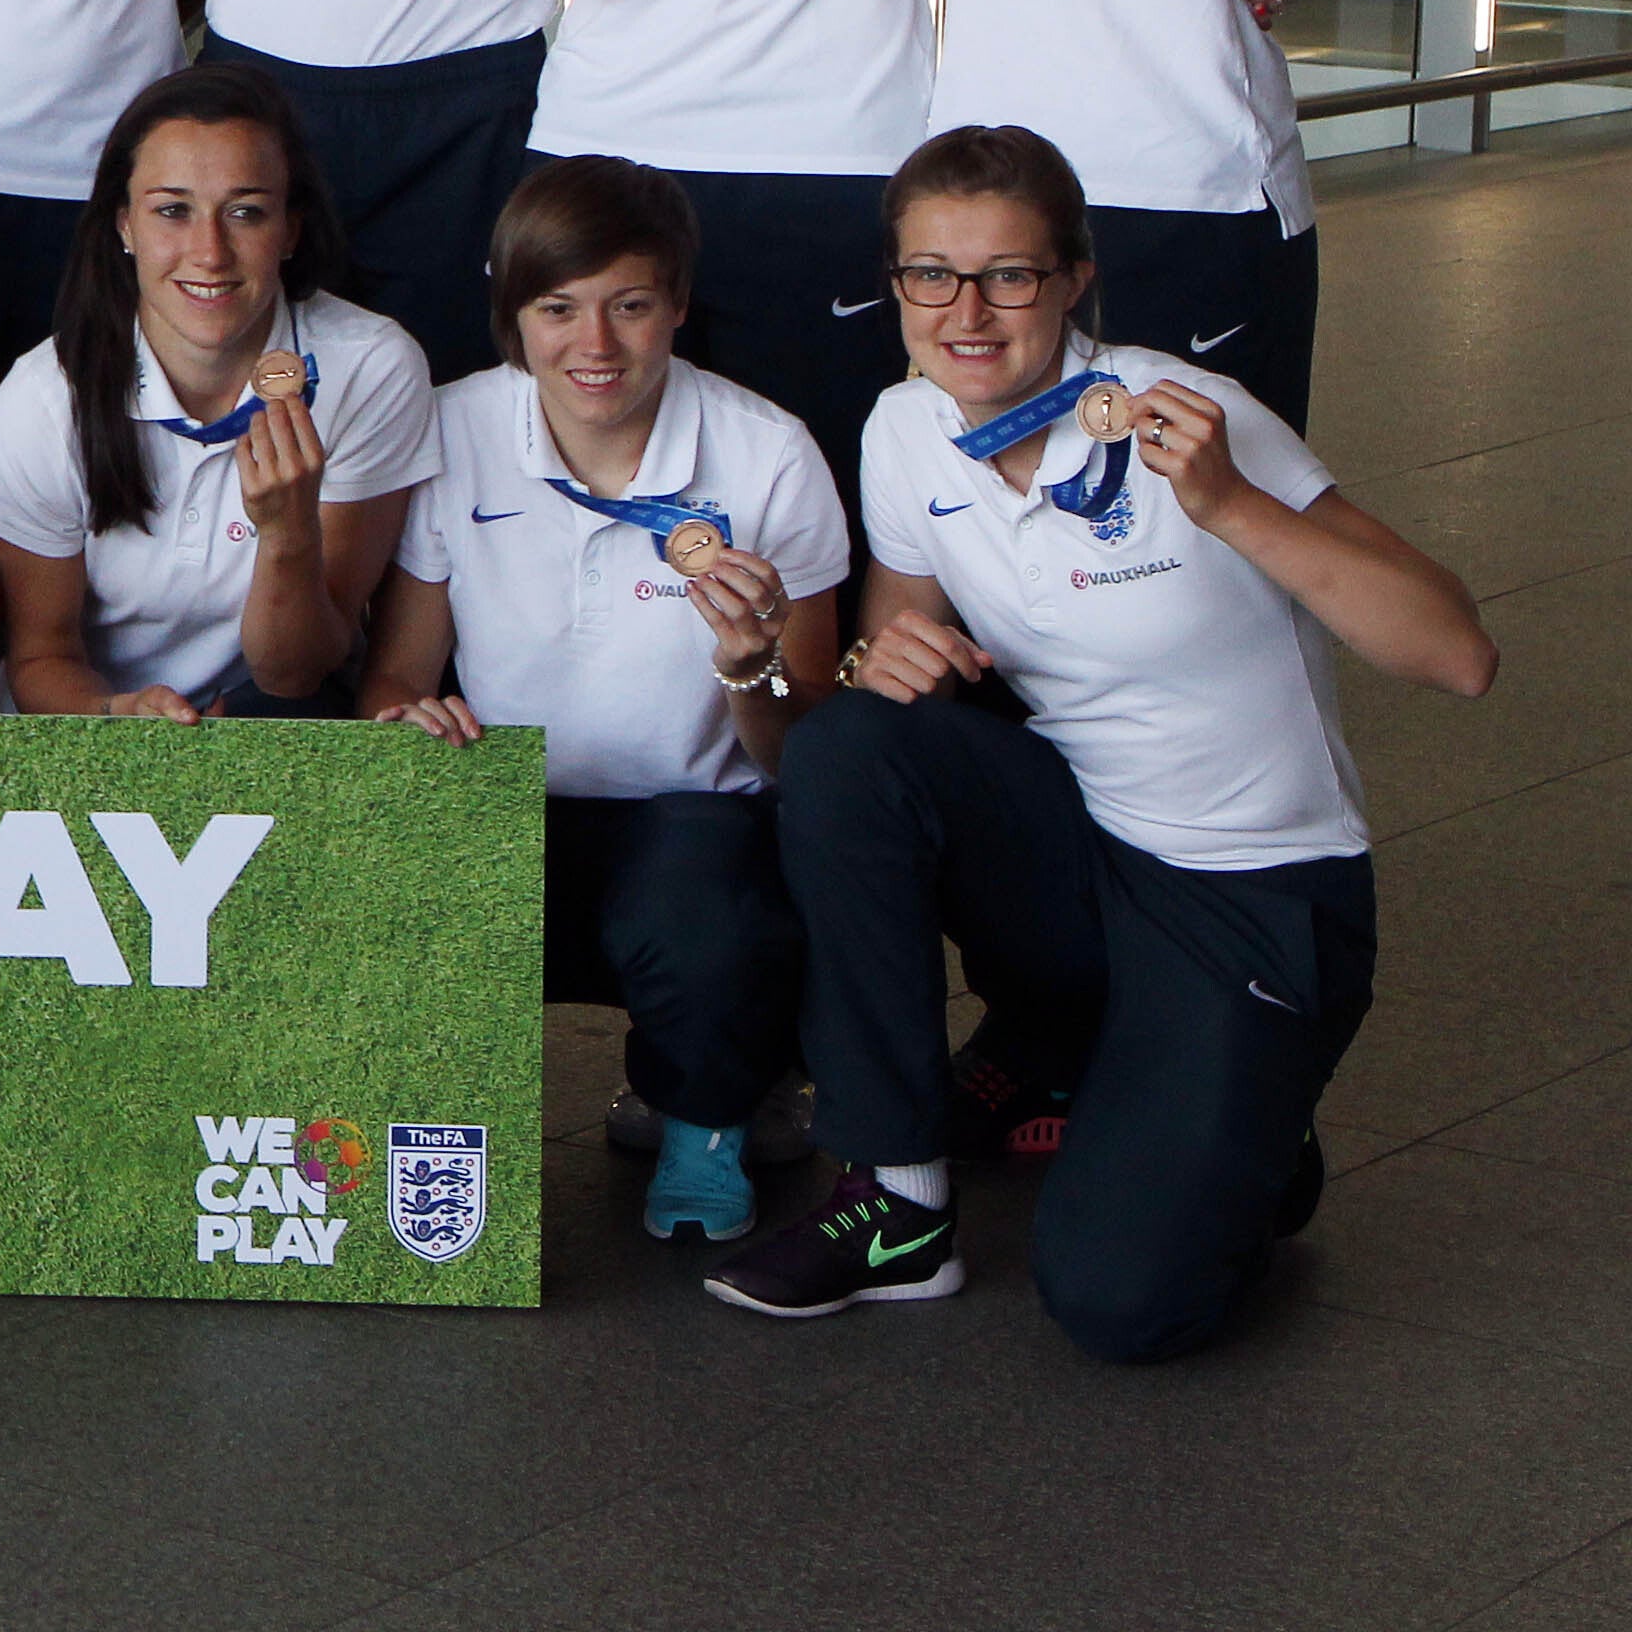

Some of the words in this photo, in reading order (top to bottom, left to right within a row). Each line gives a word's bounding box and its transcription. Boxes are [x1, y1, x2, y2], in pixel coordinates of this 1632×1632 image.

[1088, 557, 1183, 585] VAUXHALL
[195, 1115, 297, 1165] WE
[195, 1165, 327, 1215] CAN
[197, 1215, 349, 1266] PLAY
